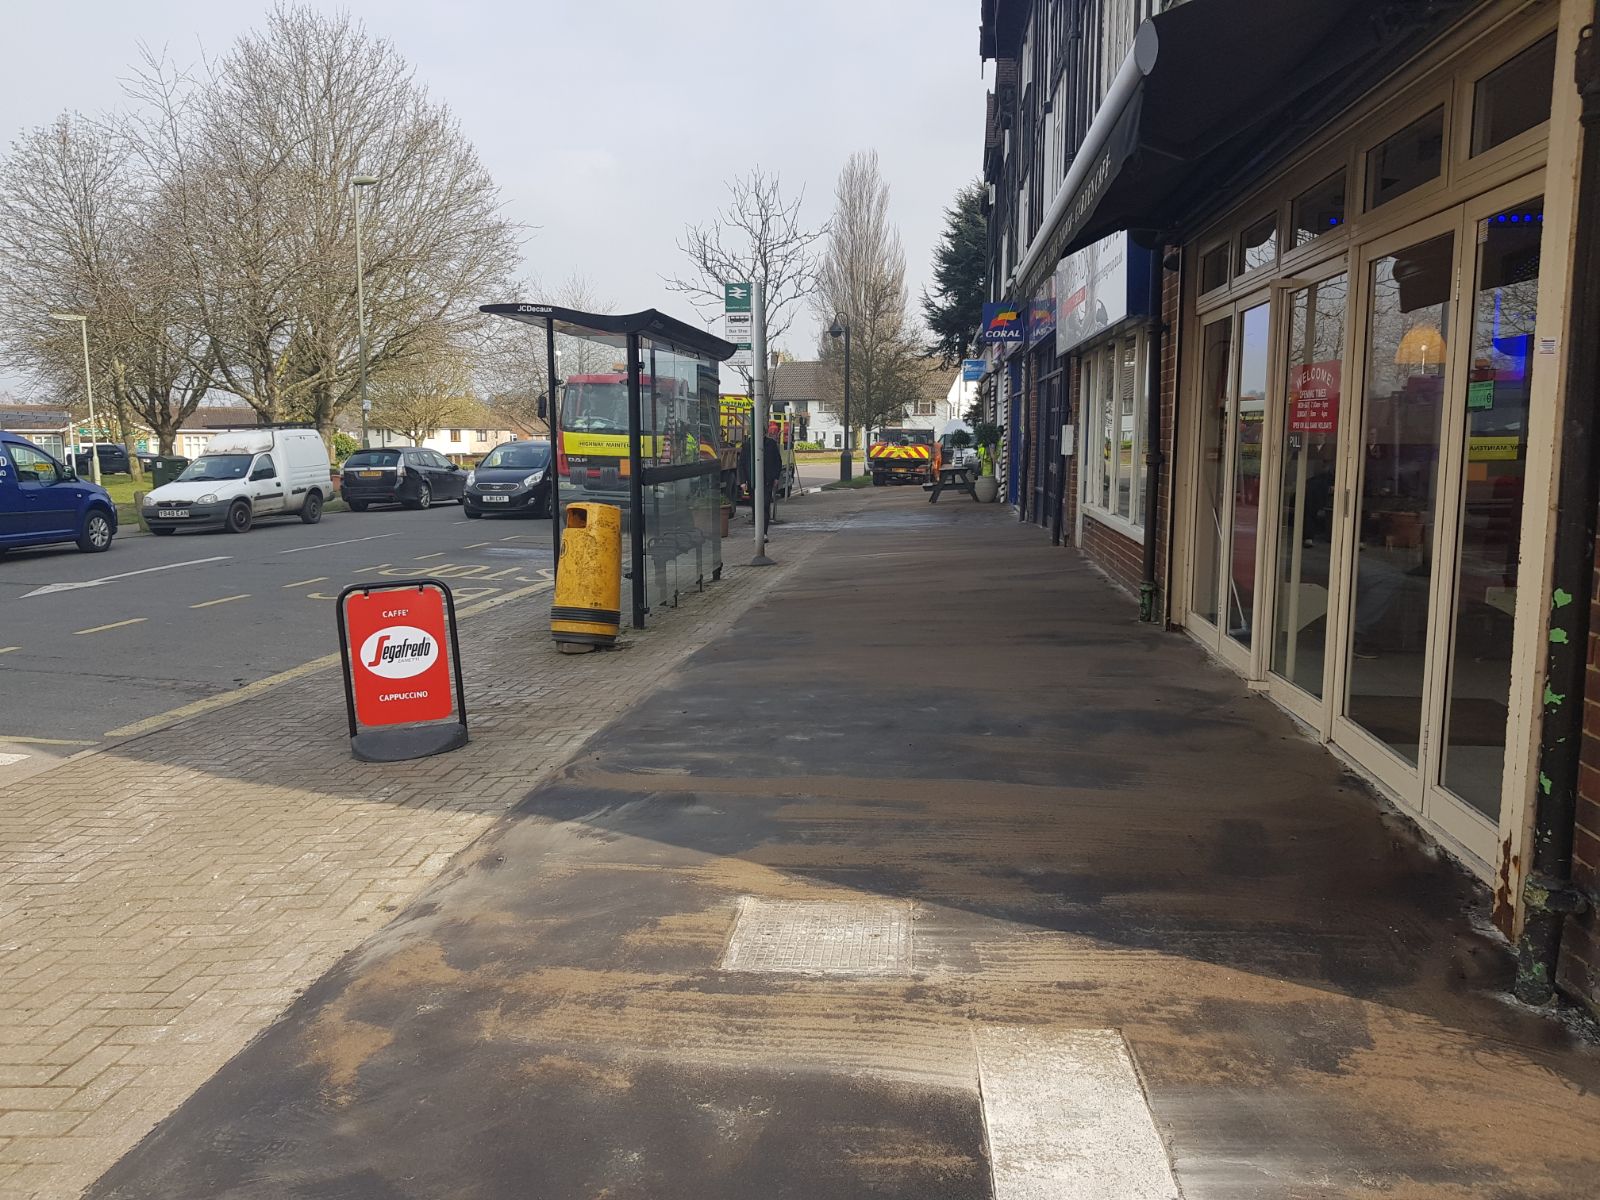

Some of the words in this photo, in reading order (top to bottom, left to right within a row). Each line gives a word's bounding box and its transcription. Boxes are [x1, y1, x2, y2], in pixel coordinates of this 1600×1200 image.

[517, 305, 553, 313] JCDecaux
[985, 330, 1021, 338] CORAL
[1296, 367, 1334, 389] WELCOME!
[1289, 435, 1301, 448] PULL
[367, 634, 431, 667] Segafredo
[379, 690, 429, 702] CAPPUCCINO
